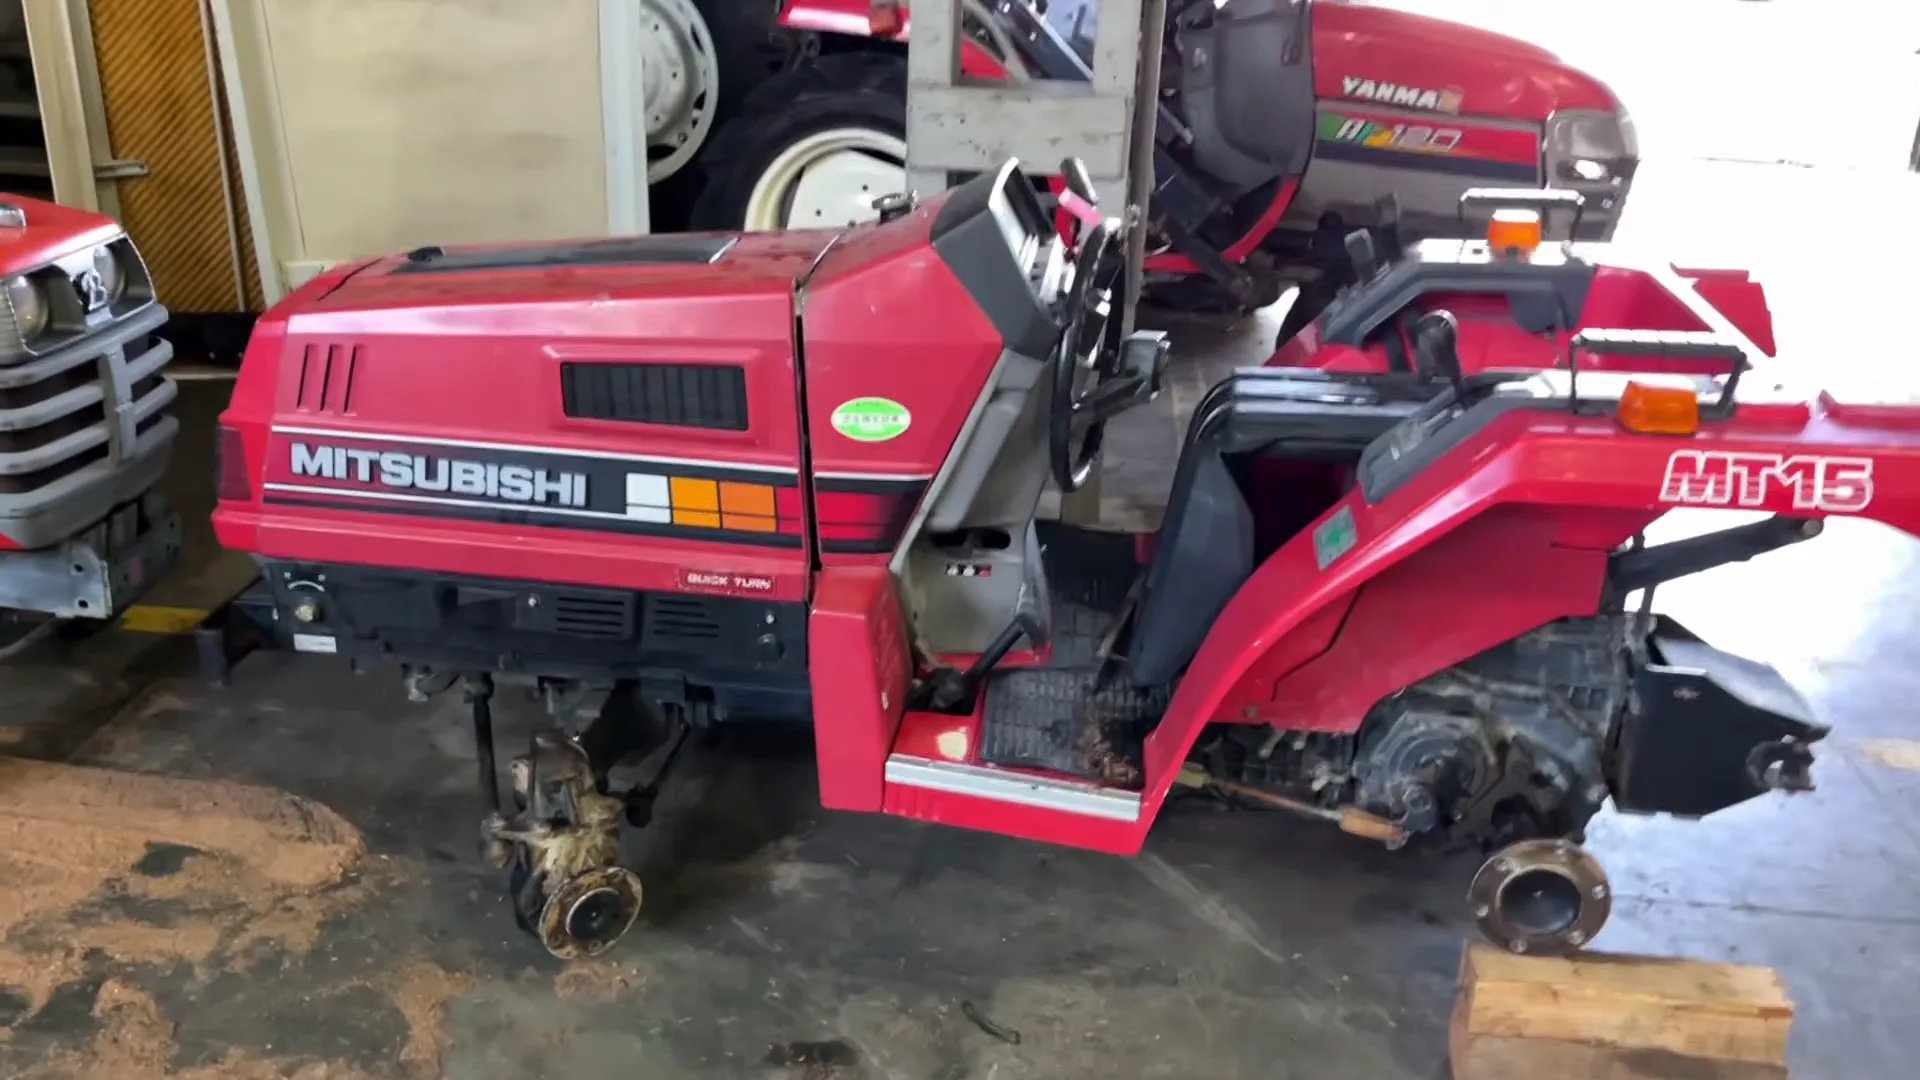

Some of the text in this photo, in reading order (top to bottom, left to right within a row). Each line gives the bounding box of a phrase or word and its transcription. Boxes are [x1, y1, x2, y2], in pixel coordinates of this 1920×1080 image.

[1342, 75, 1460, 112] YANMA
[290, 443, 588, 507] MITSUBISHI
[1659, 449, 1874, 512] MT15
